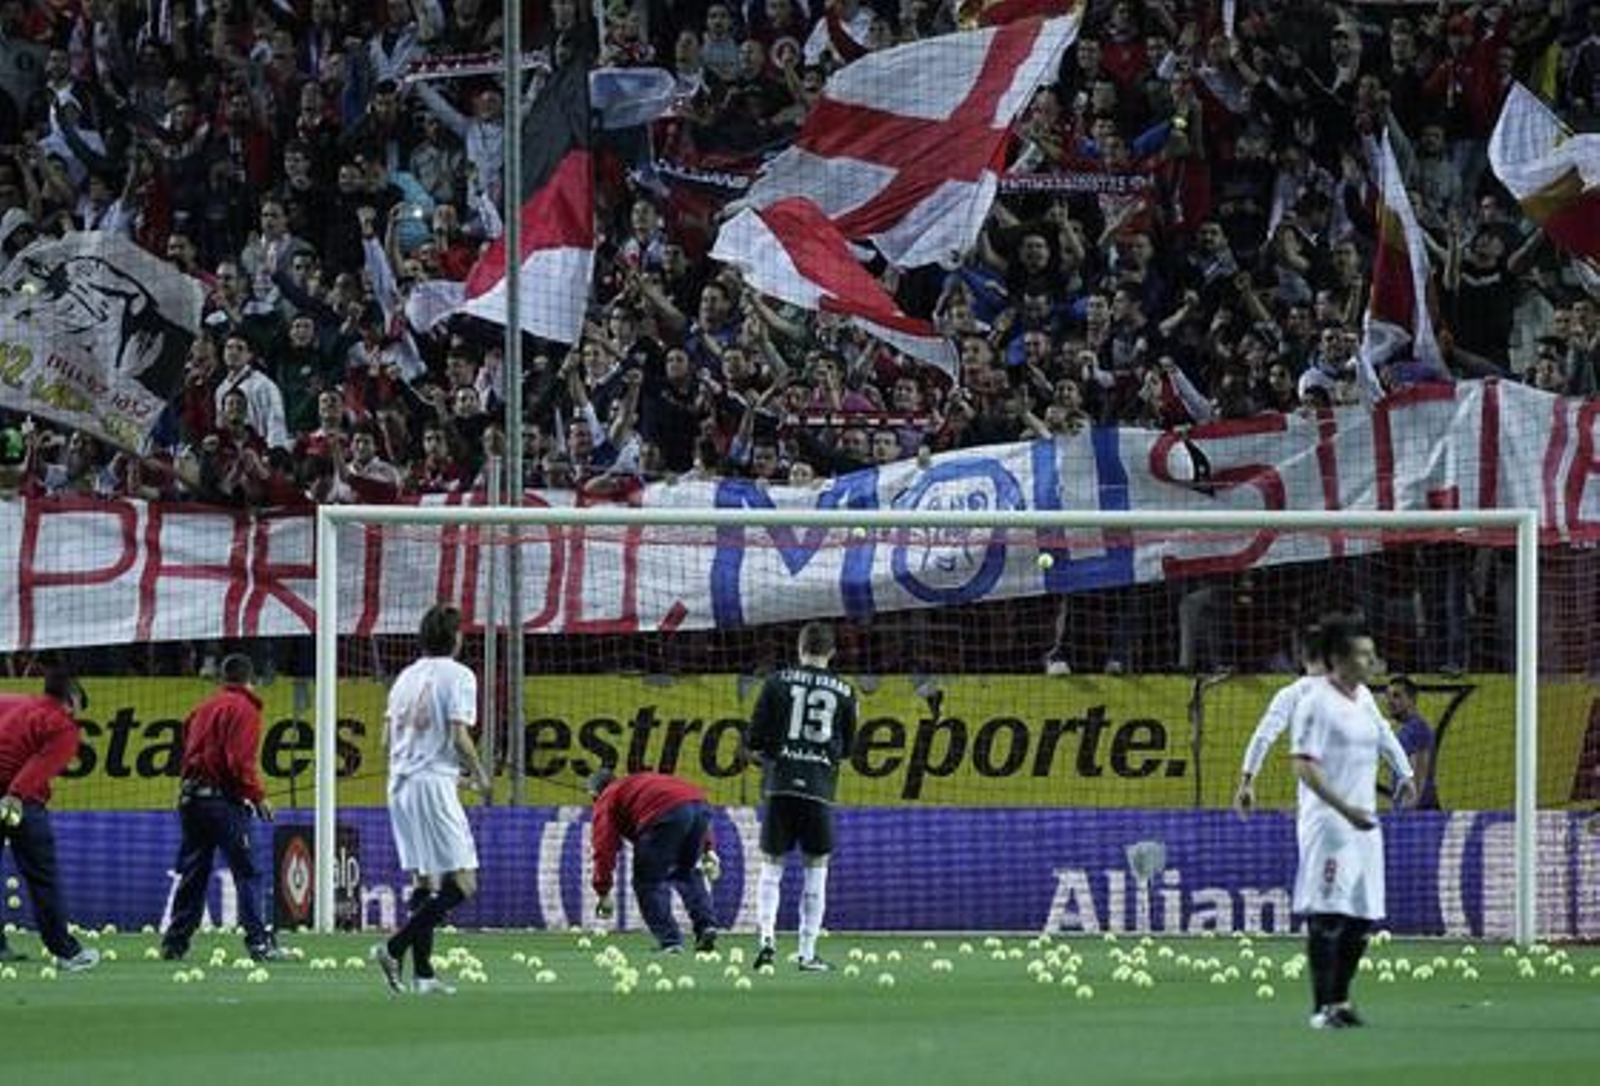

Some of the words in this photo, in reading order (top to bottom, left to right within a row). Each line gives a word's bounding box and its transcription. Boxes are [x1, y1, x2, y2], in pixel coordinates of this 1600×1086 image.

[710, 420, 1135, 629] MOU
[524, 705, 755, 779] estro
[849, 704, 1187, 801] eporte.
[787, 683, 838, 743] 13
[1044, 867, 1309, 934] Allian
